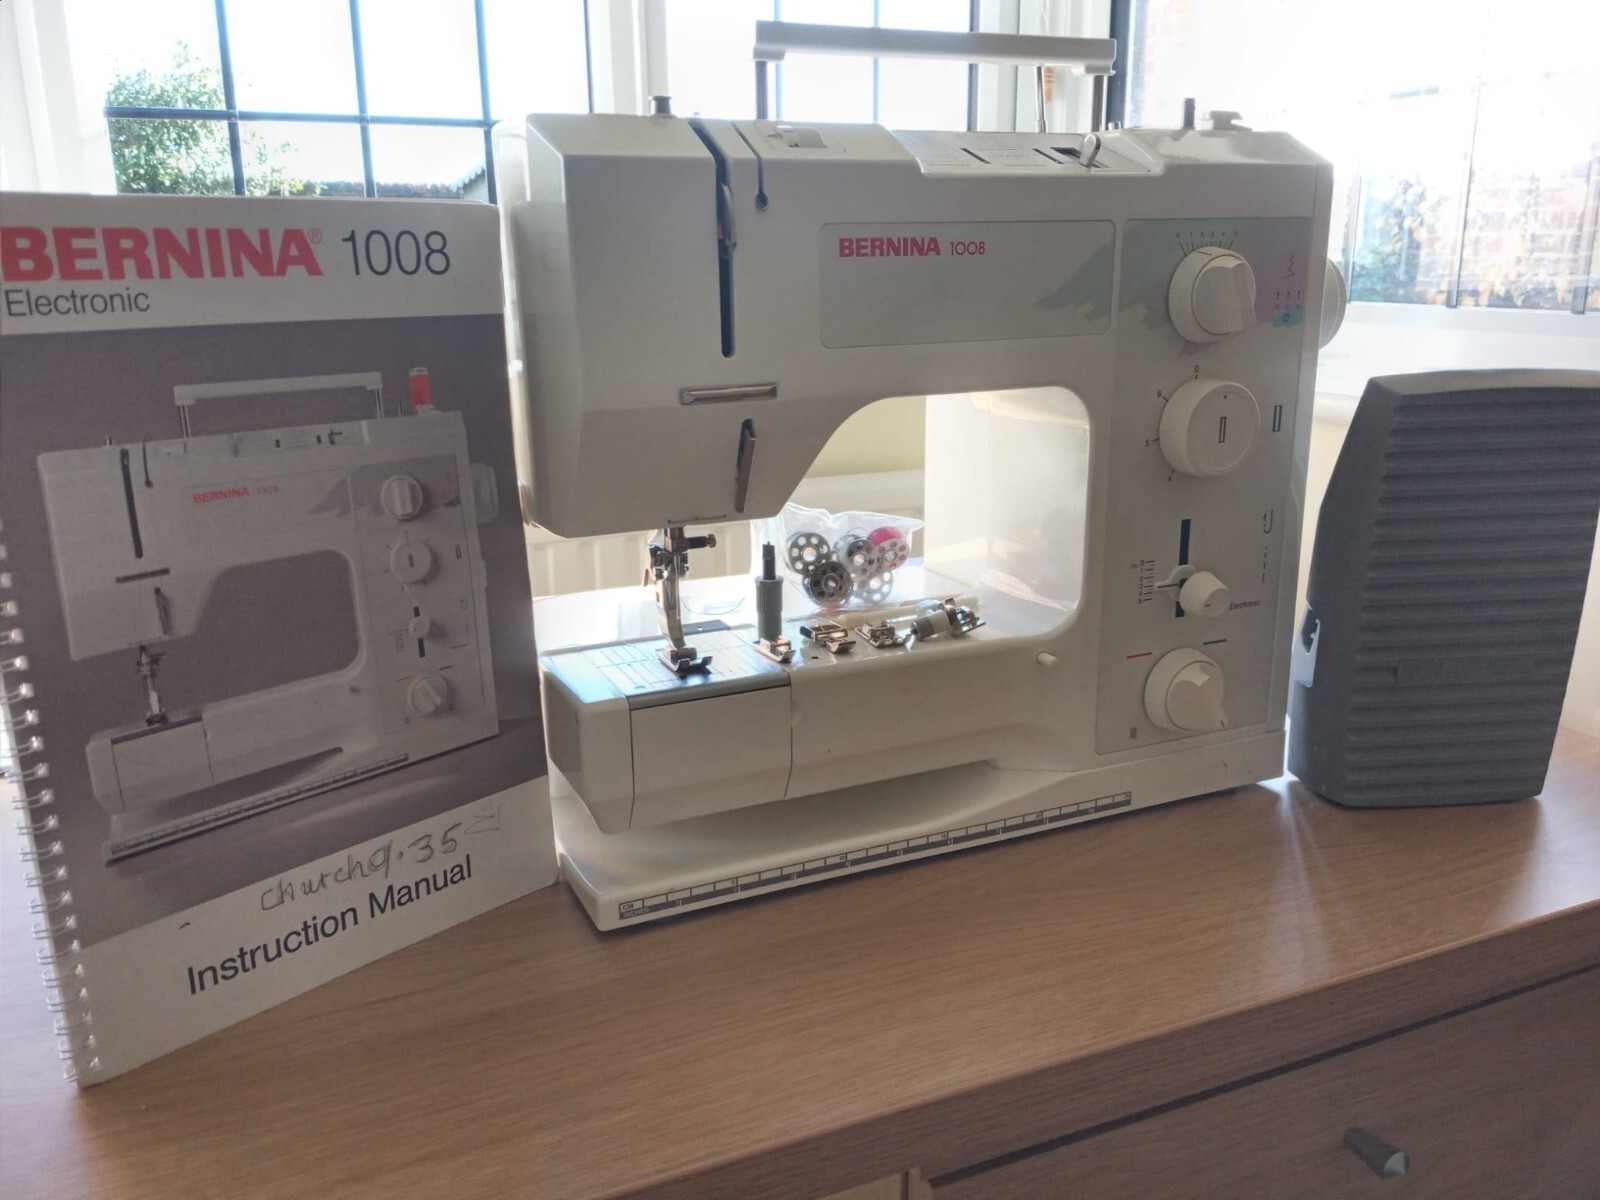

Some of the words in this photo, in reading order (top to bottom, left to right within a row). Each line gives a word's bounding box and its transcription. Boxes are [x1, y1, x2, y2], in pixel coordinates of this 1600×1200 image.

[342, 229, 451, 277] 1008
[839, 236, 941, 258] BERNINA
[950, 241, 986, 256] 1008
[4, 287, 151, 317] Electronic
[622, 903, 634, 911] CM
[187, 906, 359, 995] Instruction
[368, 853, 473, 919] Manual
